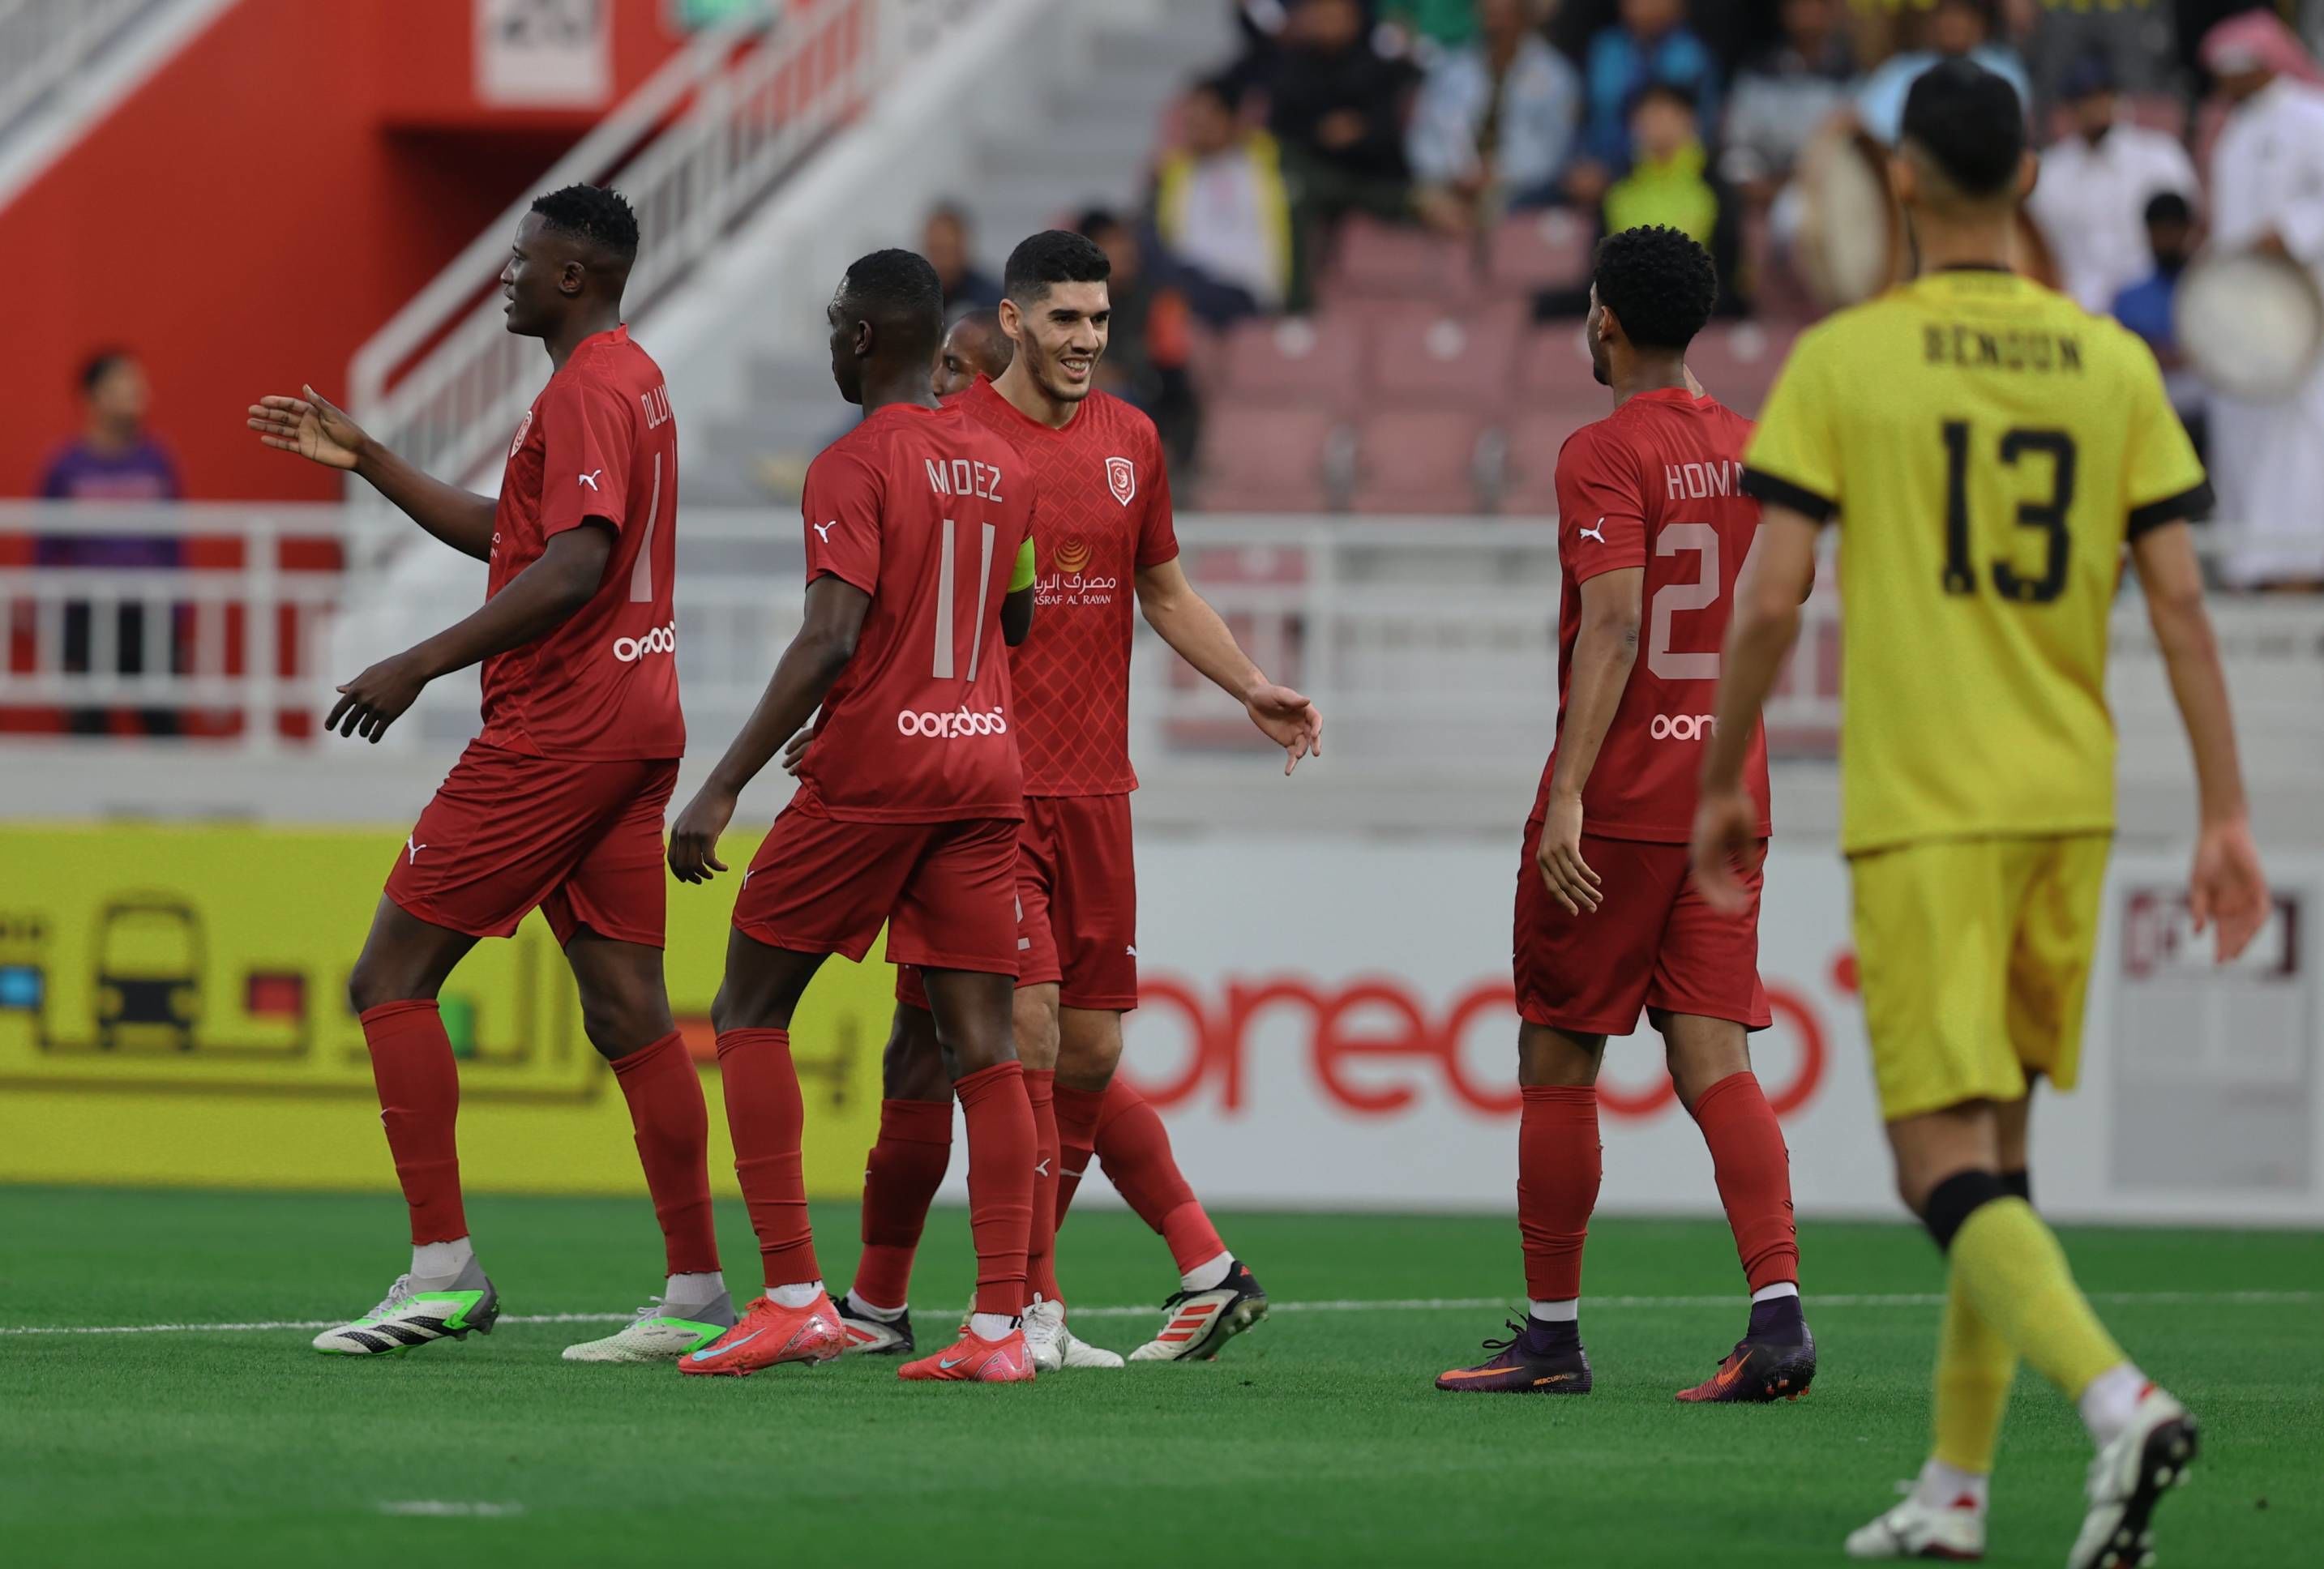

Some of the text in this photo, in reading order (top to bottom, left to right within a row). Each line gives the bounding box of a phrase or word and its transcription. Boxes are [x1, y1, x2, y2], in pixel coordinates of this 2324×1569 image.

[925, 459, 1003, 502] MOEZ
[1941, 418, 2078, 603] 13
[933, 519, 995, 682] 11
[1034, 573, 1060, 596] الريا
[1034, 595, 1111, 605] ASRAF AL RAYAN
[1533, 1374, 1569, 1386] MERCURIAL
